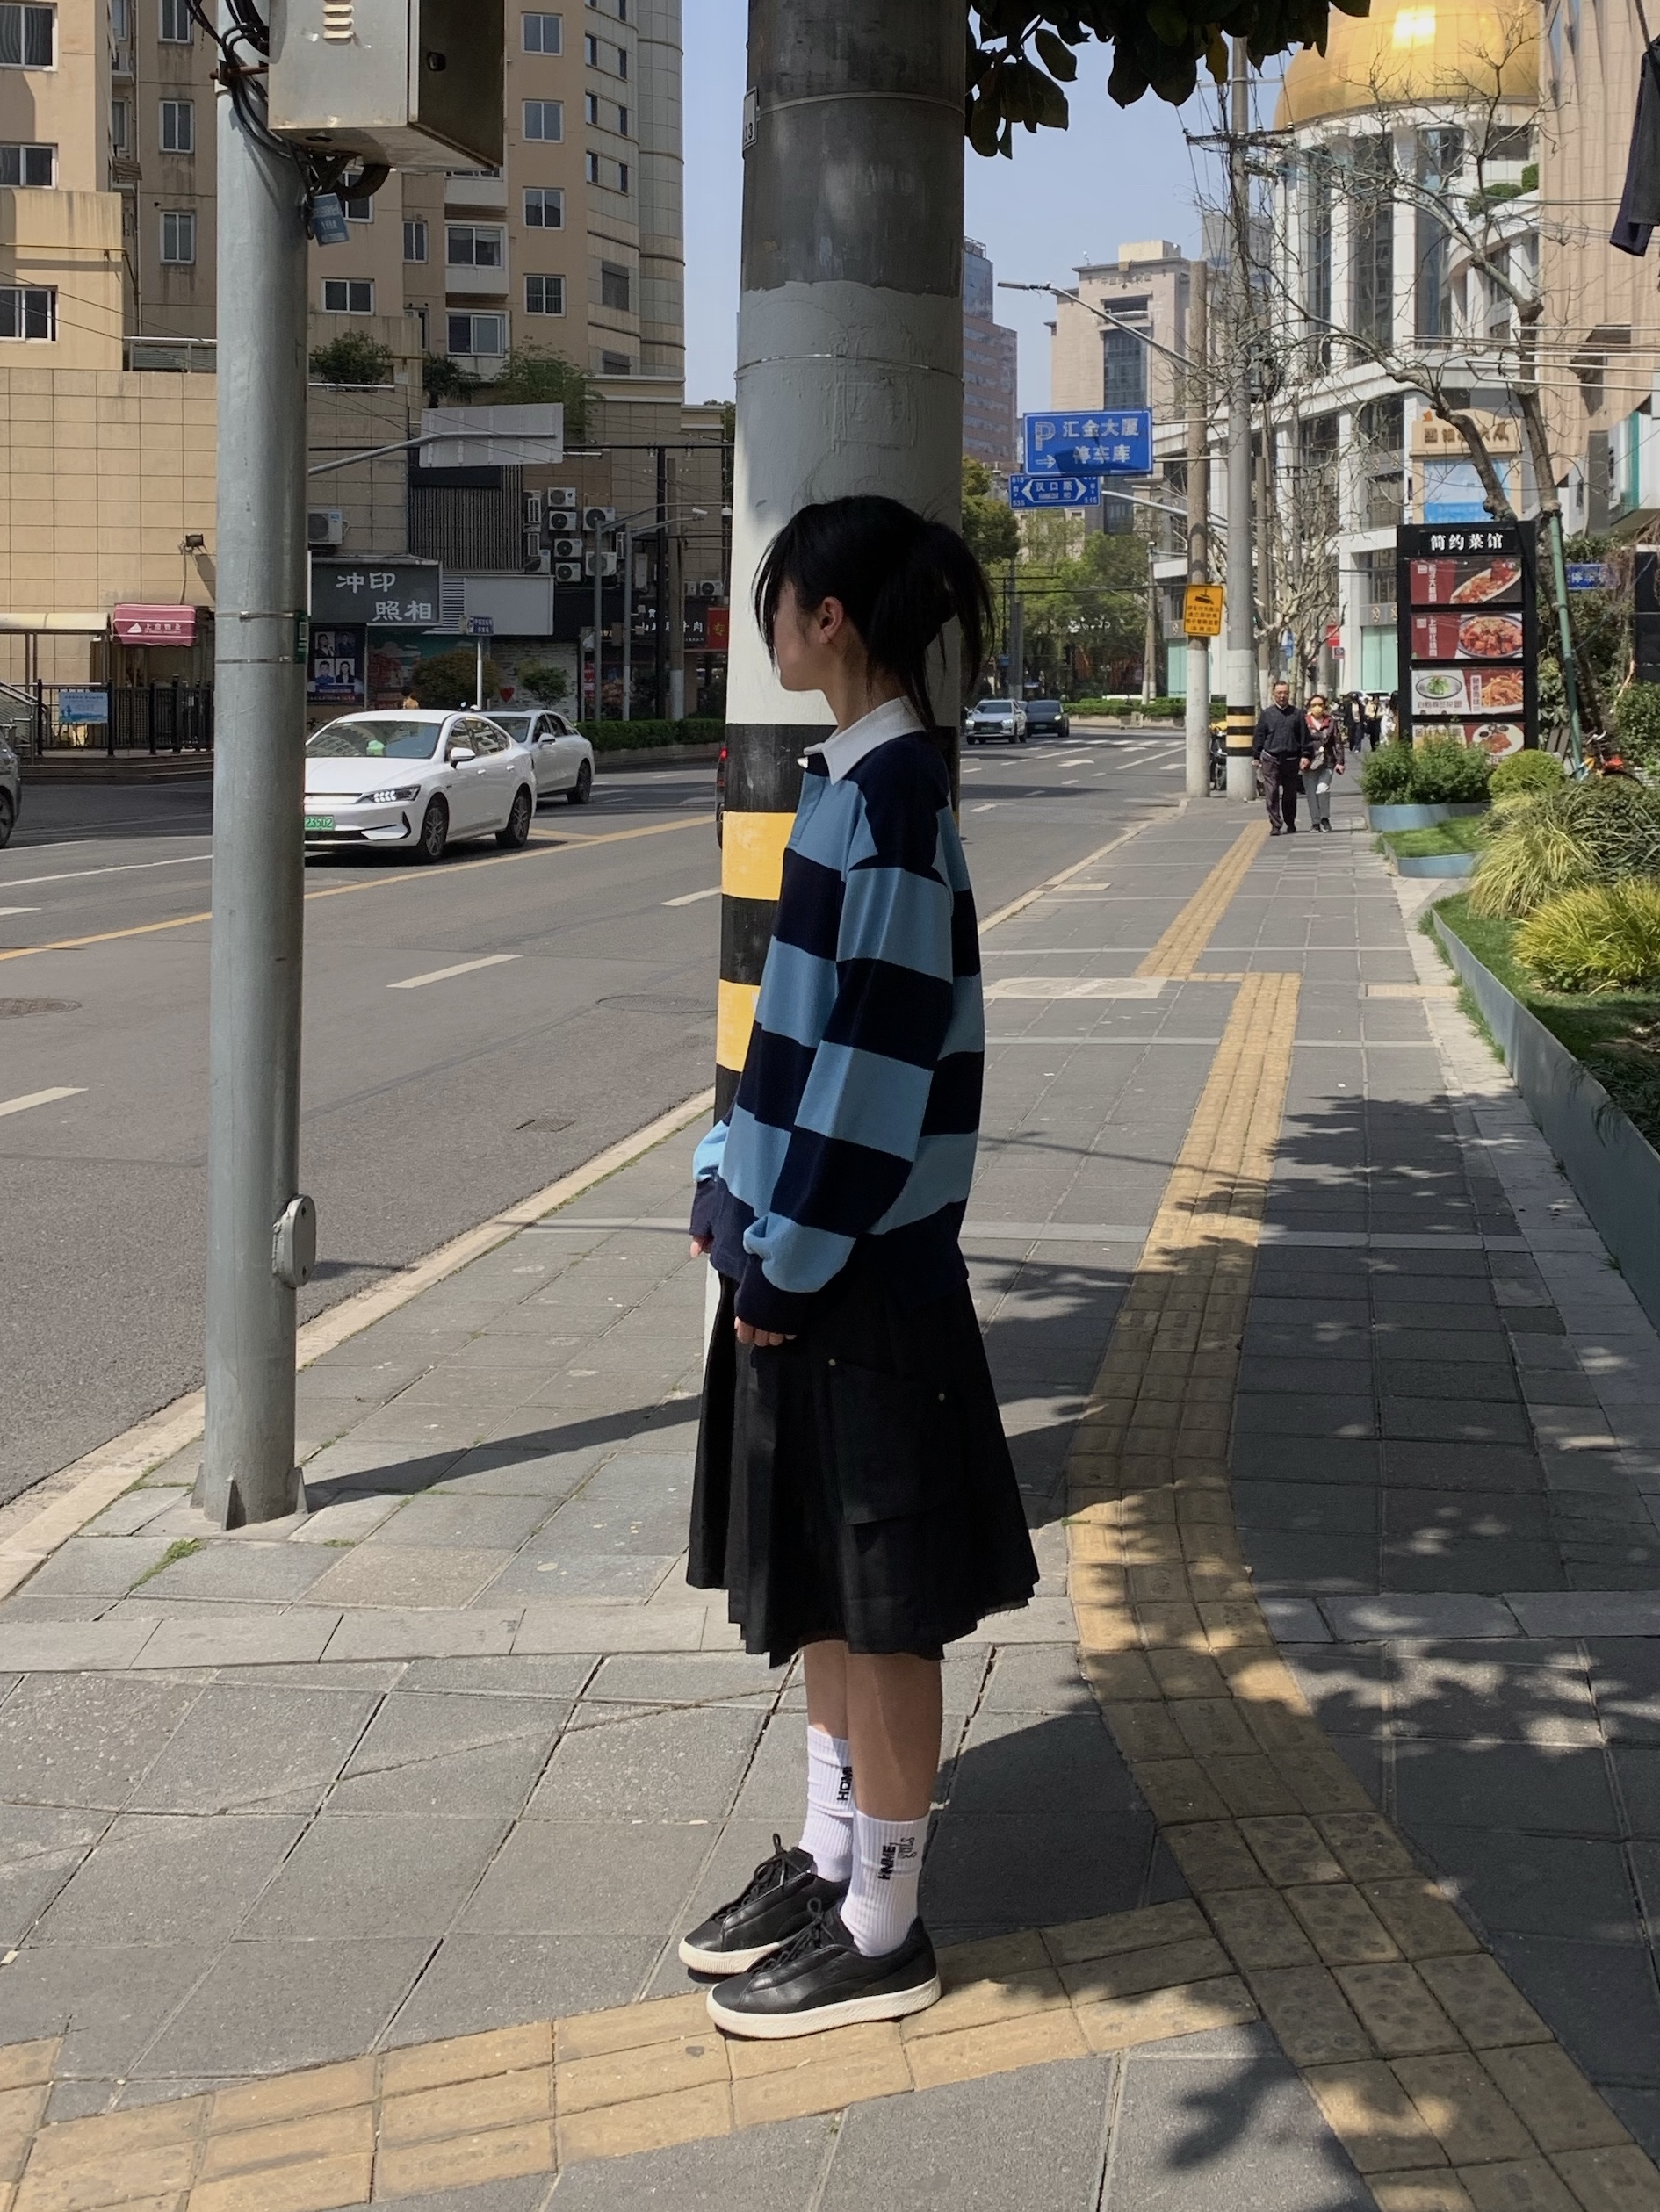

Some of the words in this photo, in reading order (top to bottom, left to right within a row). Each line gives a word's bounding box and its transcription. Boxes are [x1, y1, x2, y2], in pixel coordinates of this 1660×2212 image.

[1035, 422, 1055, 451] P
[1063, 418, 1139, 438] 汇金大厦
[1072, 444, 1131, 465] 停车库
[1036, 481, 1072, 492] 汉口路
[1430, 532, 1504, 551] 简约菜馆
[336, 572, 396, 594] 冲印
[372, 600, 432, 622] 照相
